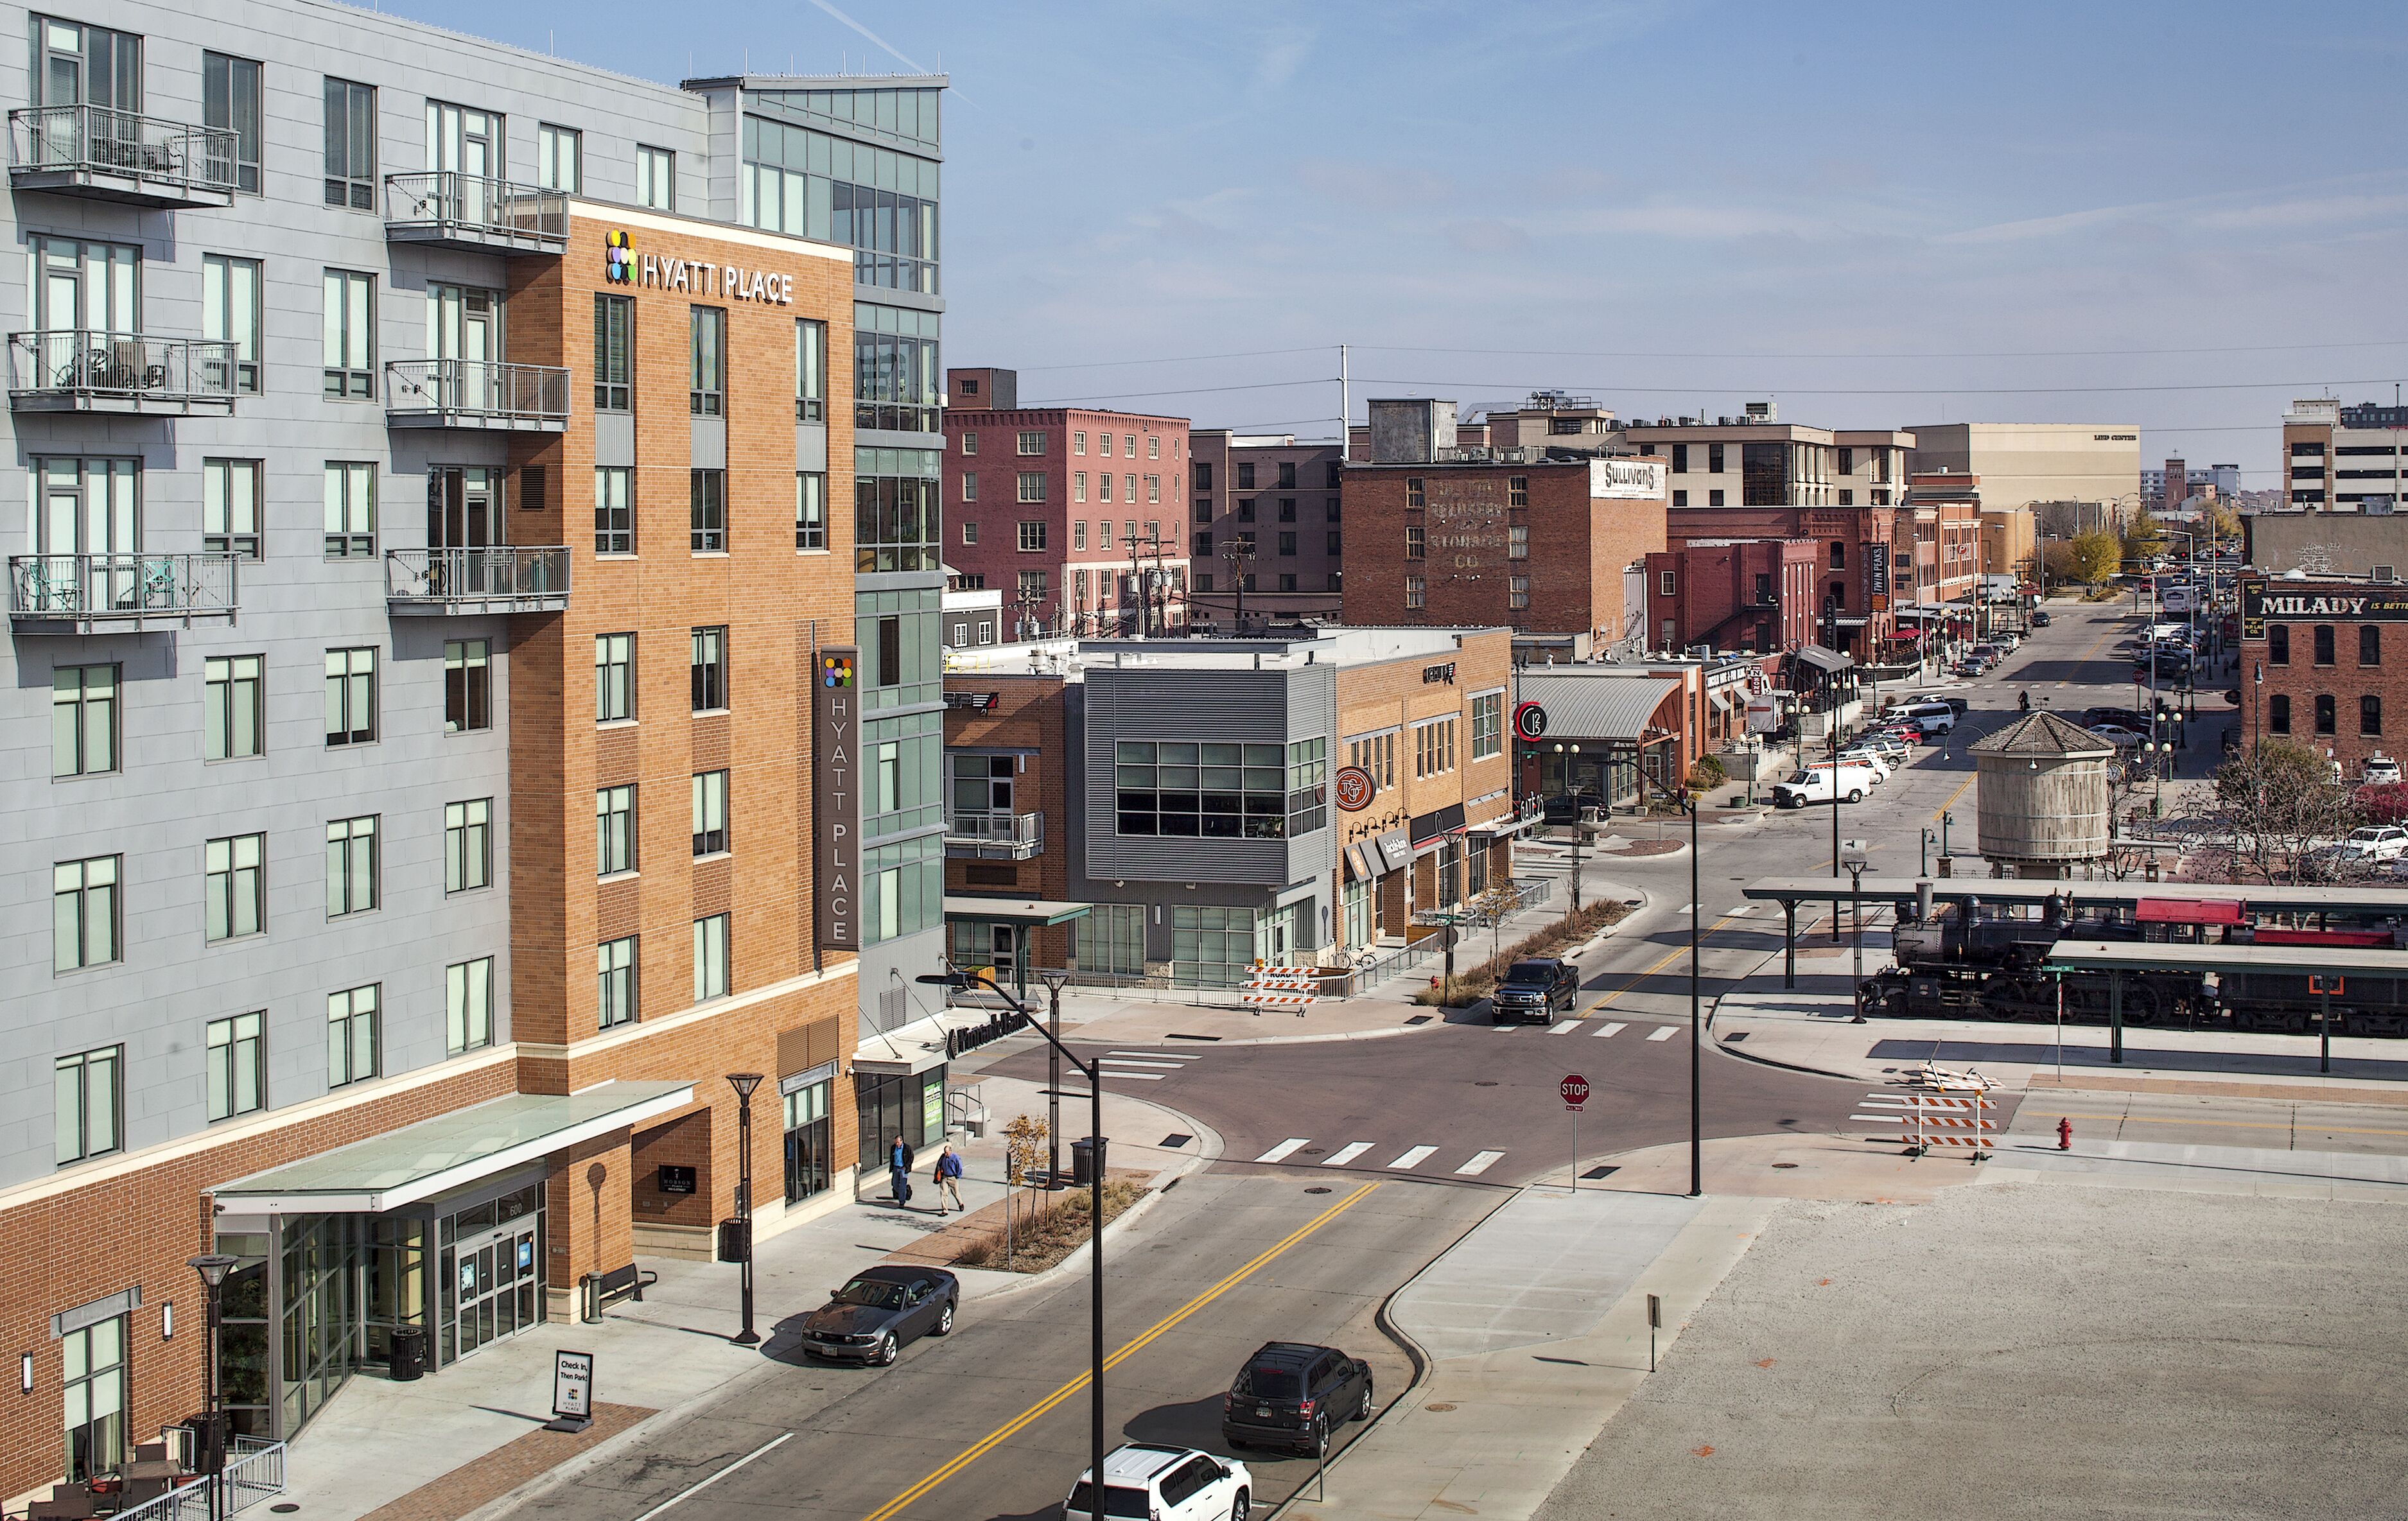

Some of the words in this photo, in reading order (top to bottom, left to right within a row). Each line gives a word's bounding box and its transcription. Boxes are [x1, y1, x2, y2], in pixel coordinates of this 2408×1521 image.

[642, 253, 716, 293] HYATT
[724, 266, 793, 304] PLACE
[1873, 548, 1883, 571] PEAKS
[1873, 571, 1883, 592] TWIN
[2260, 596, 2368, 614] MILADY
[830, 697, 849, 811] HYATT
[831, 823, 849, 941] PLACE
[1561, 1083, 1588, 1096] STOP
[510, 1202, 523, 1217] 600
[561, 1360, 580, 1369] Check
[561, 1371, 573, 1380] Then
[574, 1373, 588, 1382] Park!
